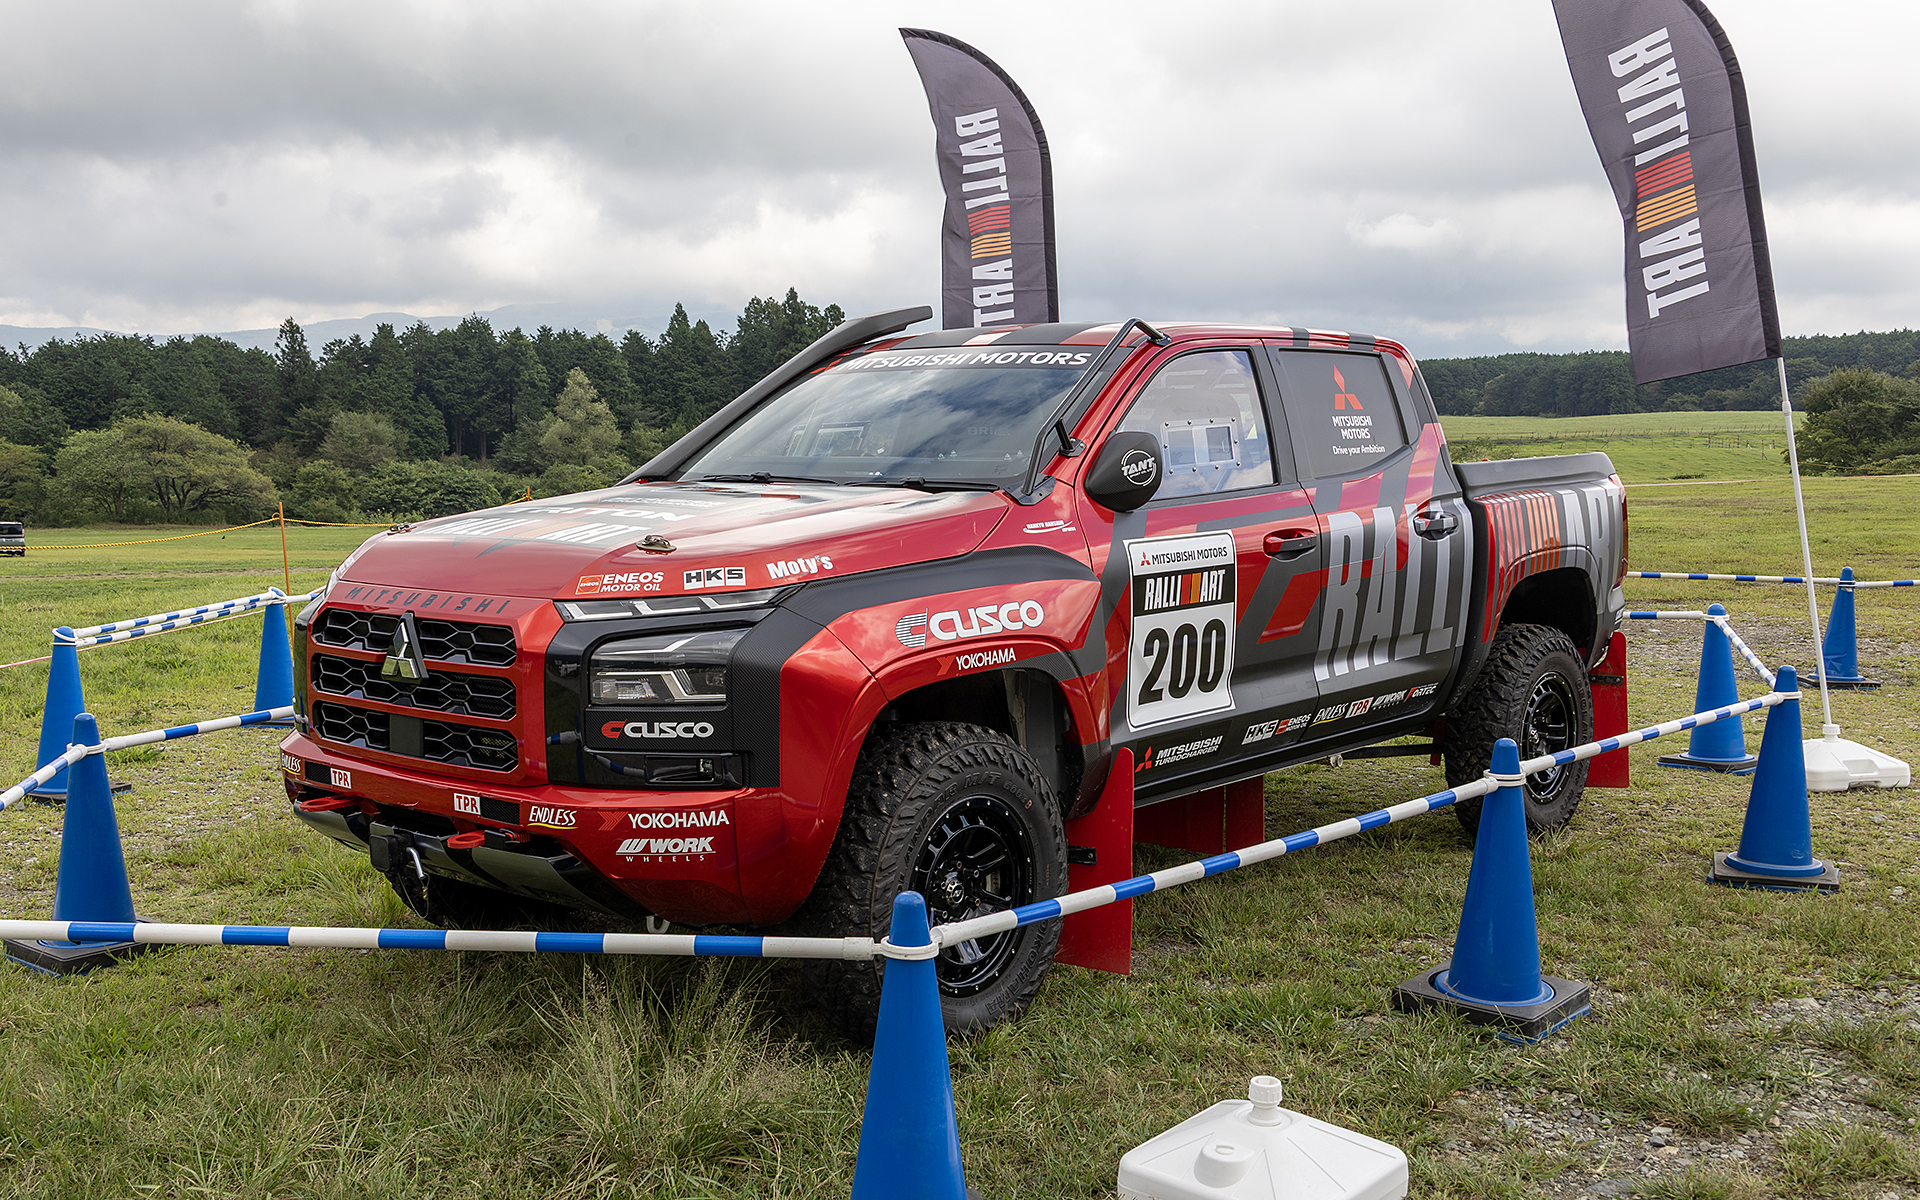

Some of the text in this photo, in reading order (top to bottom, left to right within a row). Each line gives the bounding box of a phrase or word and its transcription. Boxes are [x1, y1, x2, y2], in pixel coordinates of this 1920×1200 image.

[840, 351, 1092, 371] MITSUBISHI MOTORS
[1331, 415, 1373, 427] MITSUBISHI
[1341, 428, 1371, 440] MOTORS
[1332, 444, 1386, 457] Drive your Ambition
[1121, 457, 1155, 477] TANT
[1151, 546, 1228, 565] MITSUBISHI MOTORS
[685, 567, 744, 586] HKS
[765, 555, 834, 580] Moty's
[600, 583, 662, 593] MOTOR OIL
[601, 572, 664, 585] ENEOS
[344, 586, 512, 615] MITSUBISHI
[928, 599, 1045, 641] CUSCO
[955, 647, 1017, 671] YOKOHAMA
[1137, 618, 1227, 706] 200
[1312, 702, 1350, 723] ENDLESS
[1349, 698, 1370, 716] TPR
[623, 722, 715, 739] CUSCO
[1245, 720, 1277, 739] HKS
[1154, 745, 1219, 767] TURBOCHARGER
[1156, 735, 1223, 760] MITSUBISHI
[332, 769, 351, 788] TPR
[455, 794, 480, 814] TPR
[528, 805, 578, 826] ENDLESS
[627, 810, 730, 829] YOKOHAMA
[625, 855, 706, 863] WHEELS
